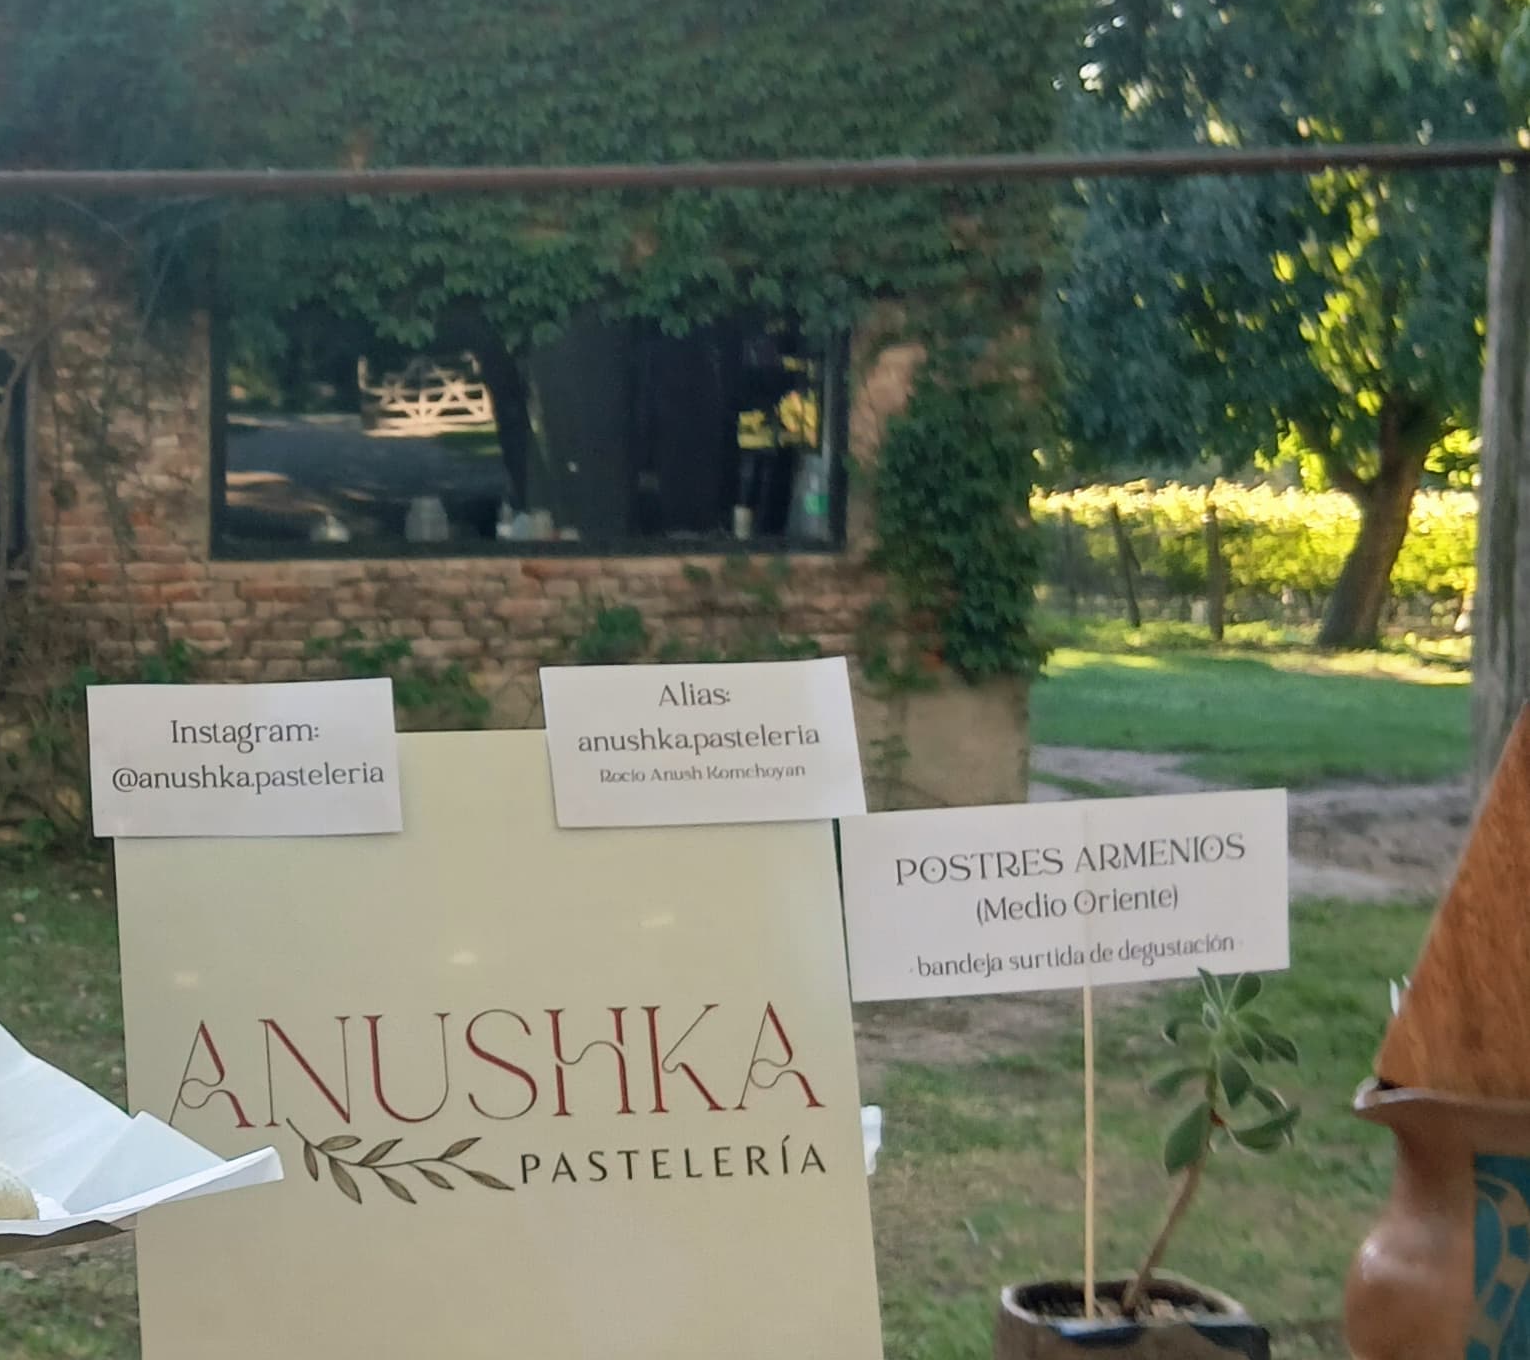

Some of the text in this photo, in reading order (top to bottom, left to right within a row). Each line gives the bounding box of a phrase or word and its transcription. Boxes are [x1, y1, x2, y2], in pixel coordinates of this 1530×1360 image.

[658, 681, 731, 707] Alias:
[170, 720, 319, 754] Instagram:
[578, 724, 820, 755] anushka.pasteleria
[112, 762, 384, 796] @anushka.pasteleria
[650, 765, 702, 782] Anush
[895, 832, 1246, 887] POSTRES ARMENIOS
[976, 884, 1179, 928] (Medio Oriente)
[917, 933, 1235, 978] bandeja surtida de degustación
[168, 1000, 826, 1129] ANUSHKA
[520, 1134, 827, 1185] PASTELERÍA
